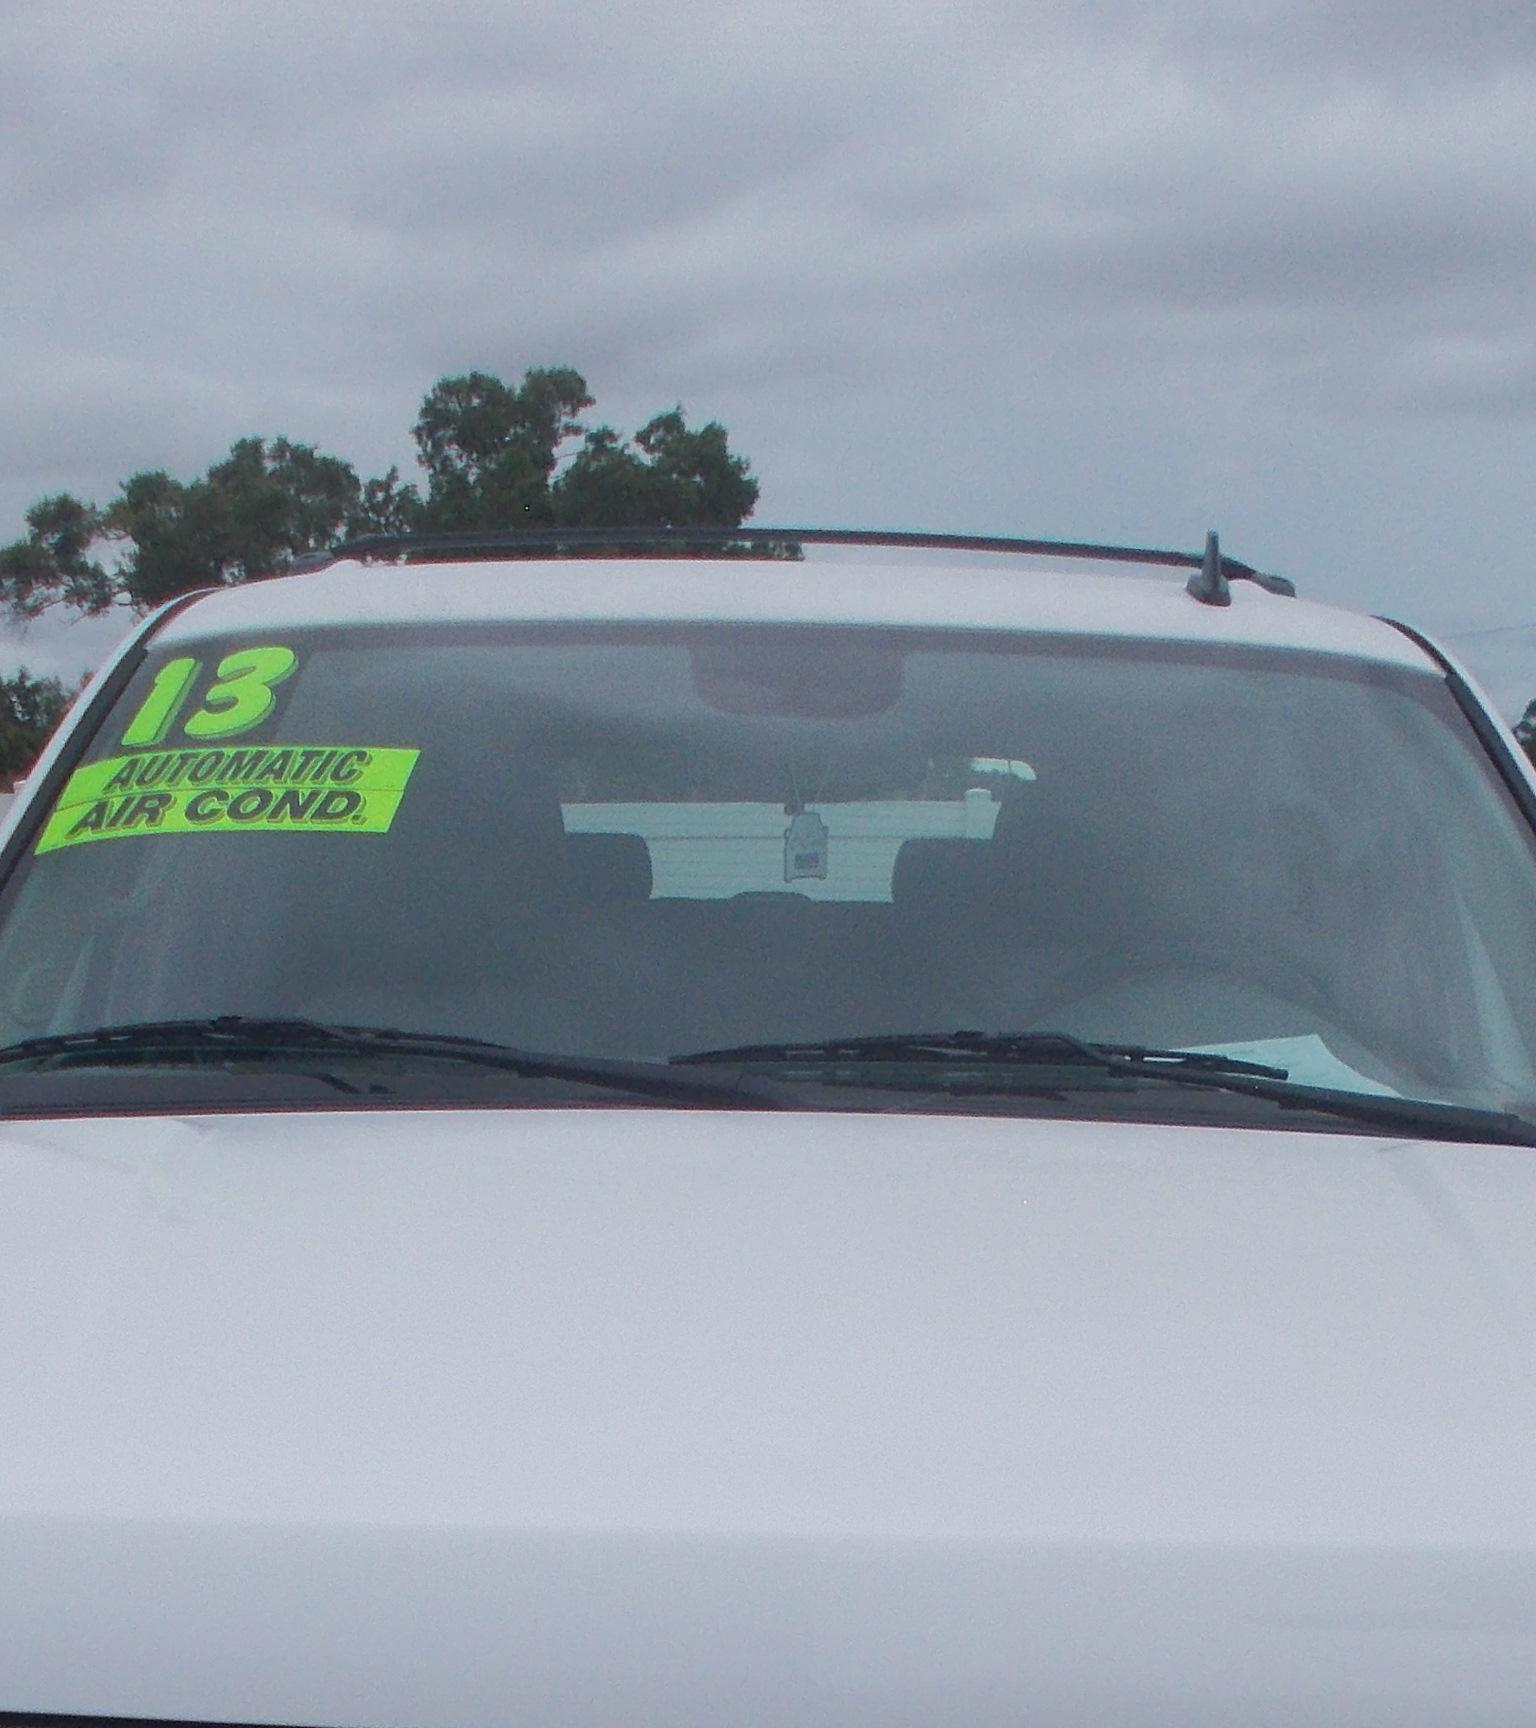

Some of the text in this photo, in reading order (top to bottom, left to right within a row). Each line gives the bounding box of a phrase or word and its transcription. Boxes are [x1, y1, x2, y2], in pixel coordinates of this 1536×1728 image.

[121, 647, 298, 746] 13
[104, 750, 372, 794] AUTOMATIC
[65, 788, 368, 839] AIR COND.
